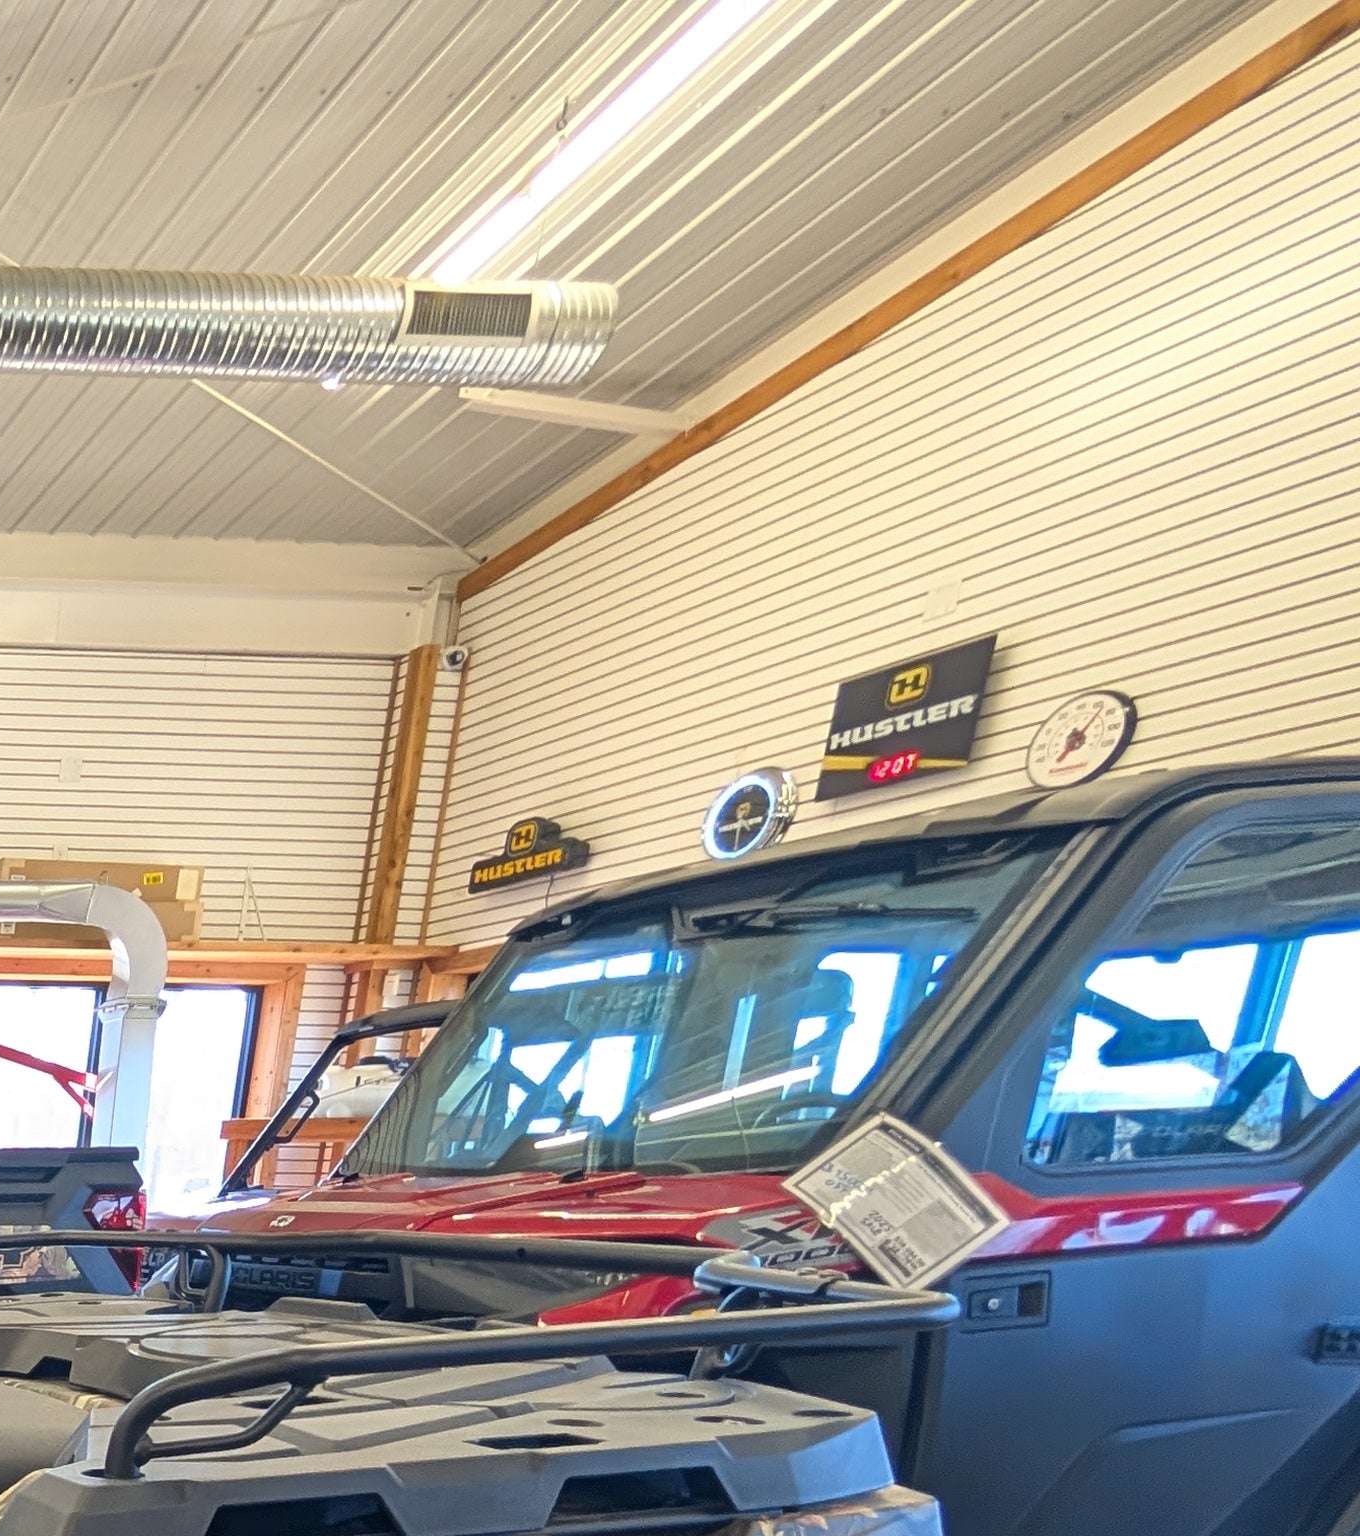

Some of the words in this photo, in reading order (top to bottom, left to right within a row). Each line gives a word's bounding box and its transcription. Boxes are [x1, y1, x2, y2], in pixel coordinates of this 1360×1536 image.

[830, 694, 979, 750] HUSTLER
[474, 847, 564, 883] HUSTLER
[231, 1268, 315, 1291] OLARIS
